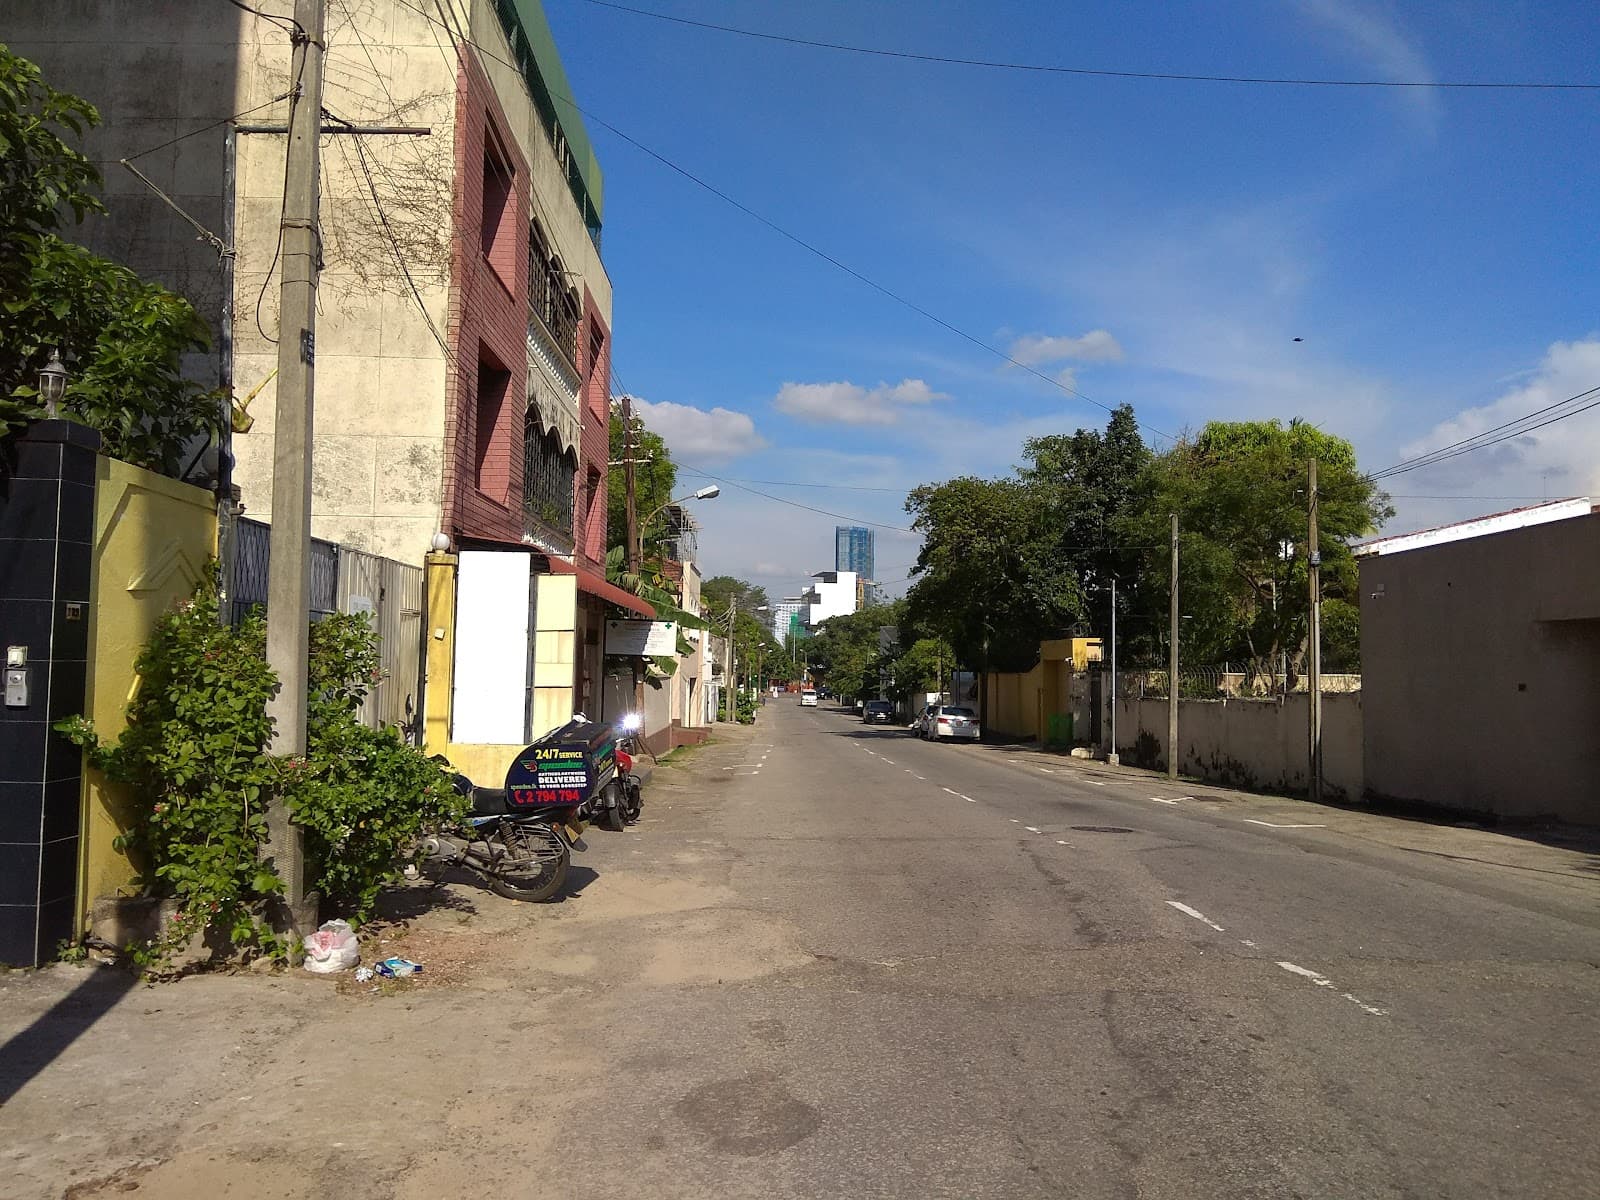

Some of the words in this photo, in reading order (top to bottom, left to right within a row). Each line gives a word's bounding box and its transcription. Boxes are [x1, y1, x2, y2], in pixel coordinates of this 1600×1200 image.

[535, 749, 559, 759] 24/7
[538, 776, 587, 784] DELIVERED
[526, 790, 534, 802] 2
[536, 790, 557, 802] 794
[559, 789, 579, 801] 794
